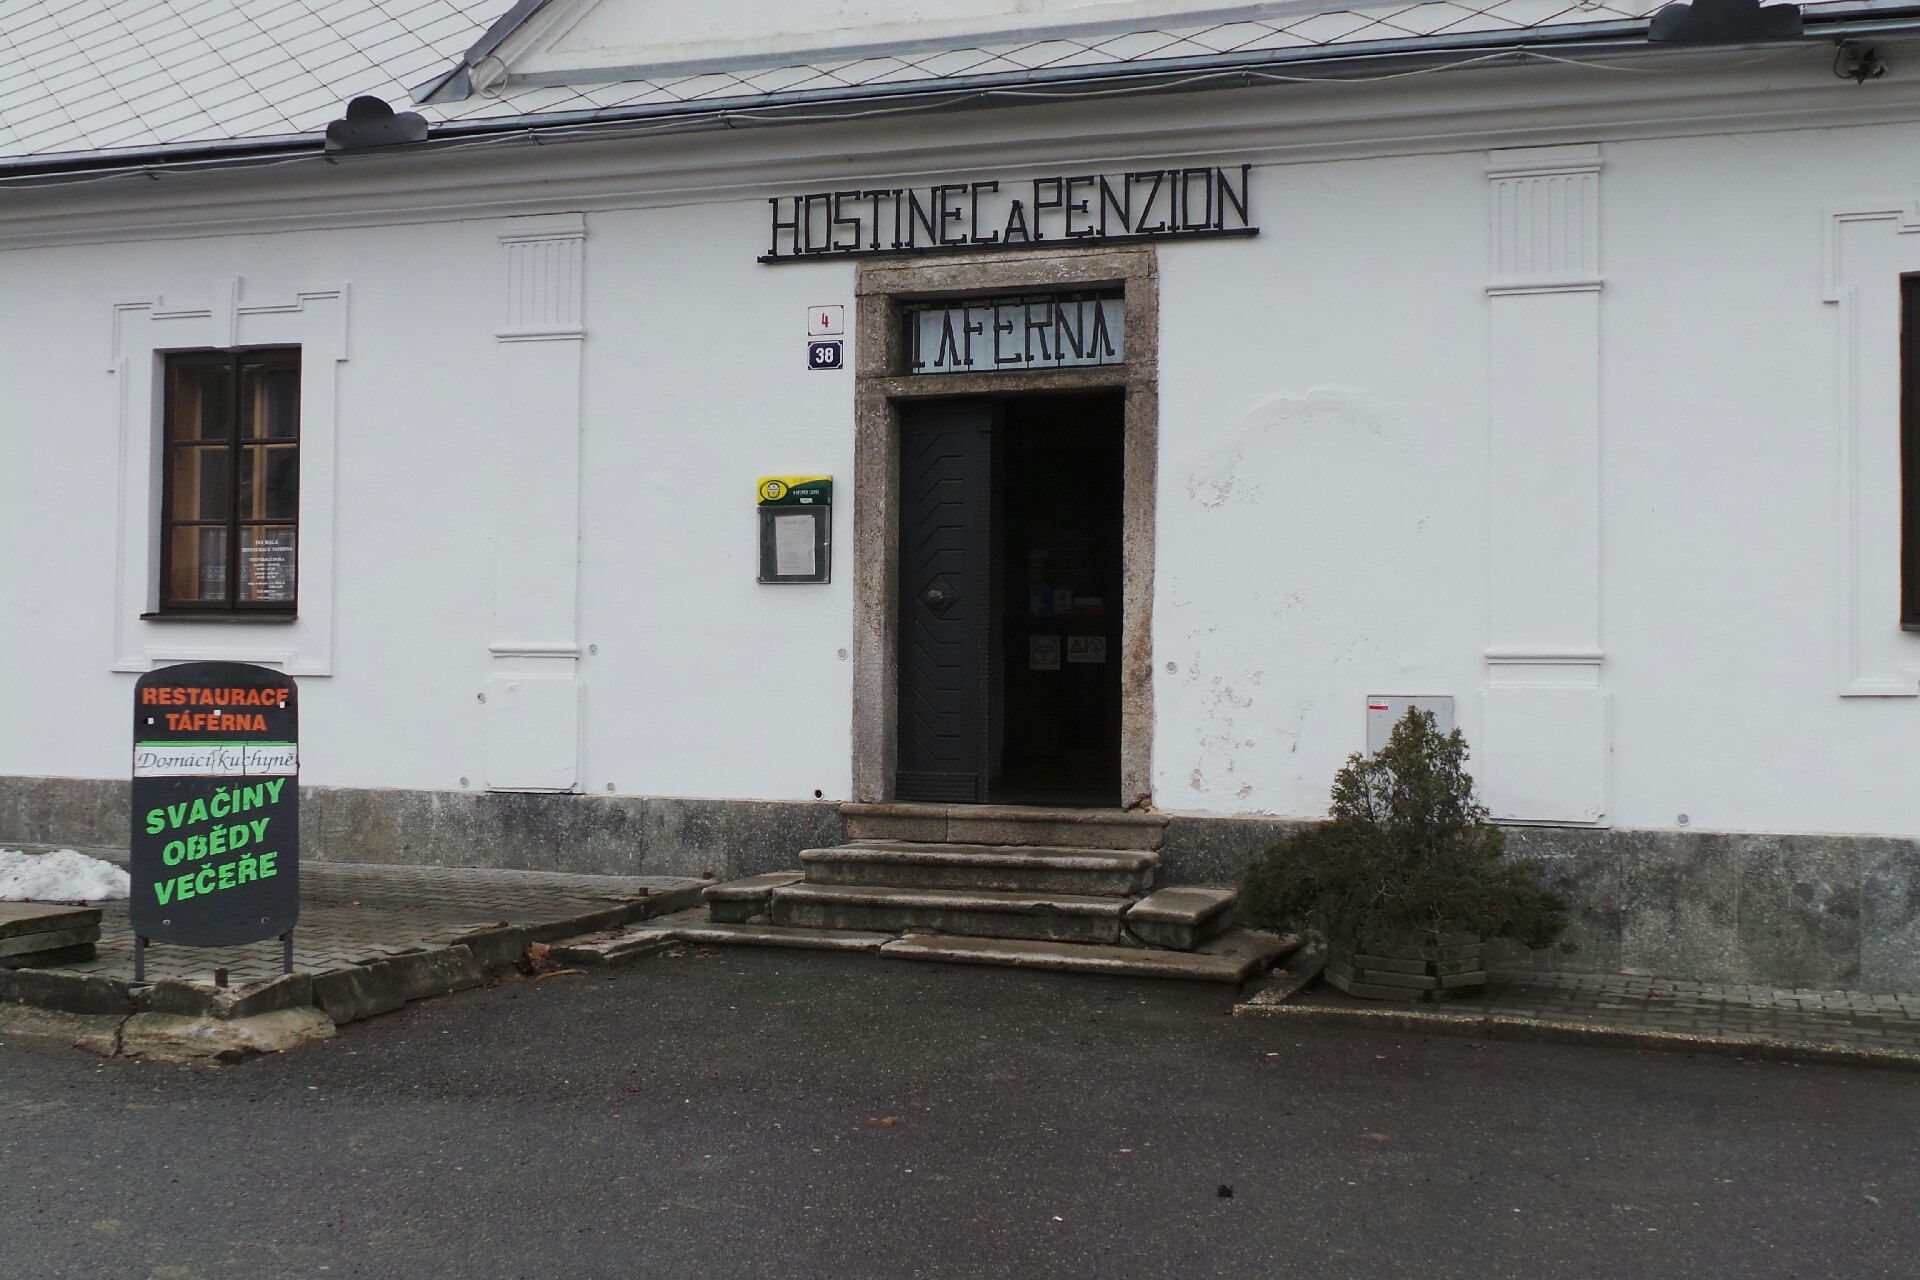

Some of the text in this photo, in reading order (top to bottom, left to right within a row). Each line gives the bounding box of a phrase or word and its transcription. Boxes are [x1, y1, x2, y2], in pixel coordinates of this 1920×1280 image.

[768, 181, 999, 256] HOSTINEC
[1033, 164, 1252, 241] PENZION
[821, 312, 829, 328] 4
[903, 292, 1115, 366] TAFERNA
[815, 347, 834, 364] 38
[142, 688, 289, 706] RESTAURACE
[165, 710, 267, 731] TÁFERNA
[138, 750, 295, 774] Domácí kuchyně
[146, 778, 286, 834] SVAČINY
[162, 817, 270, 866] OBĚDY
[154, 851, 278, 906] VEČEŘE
